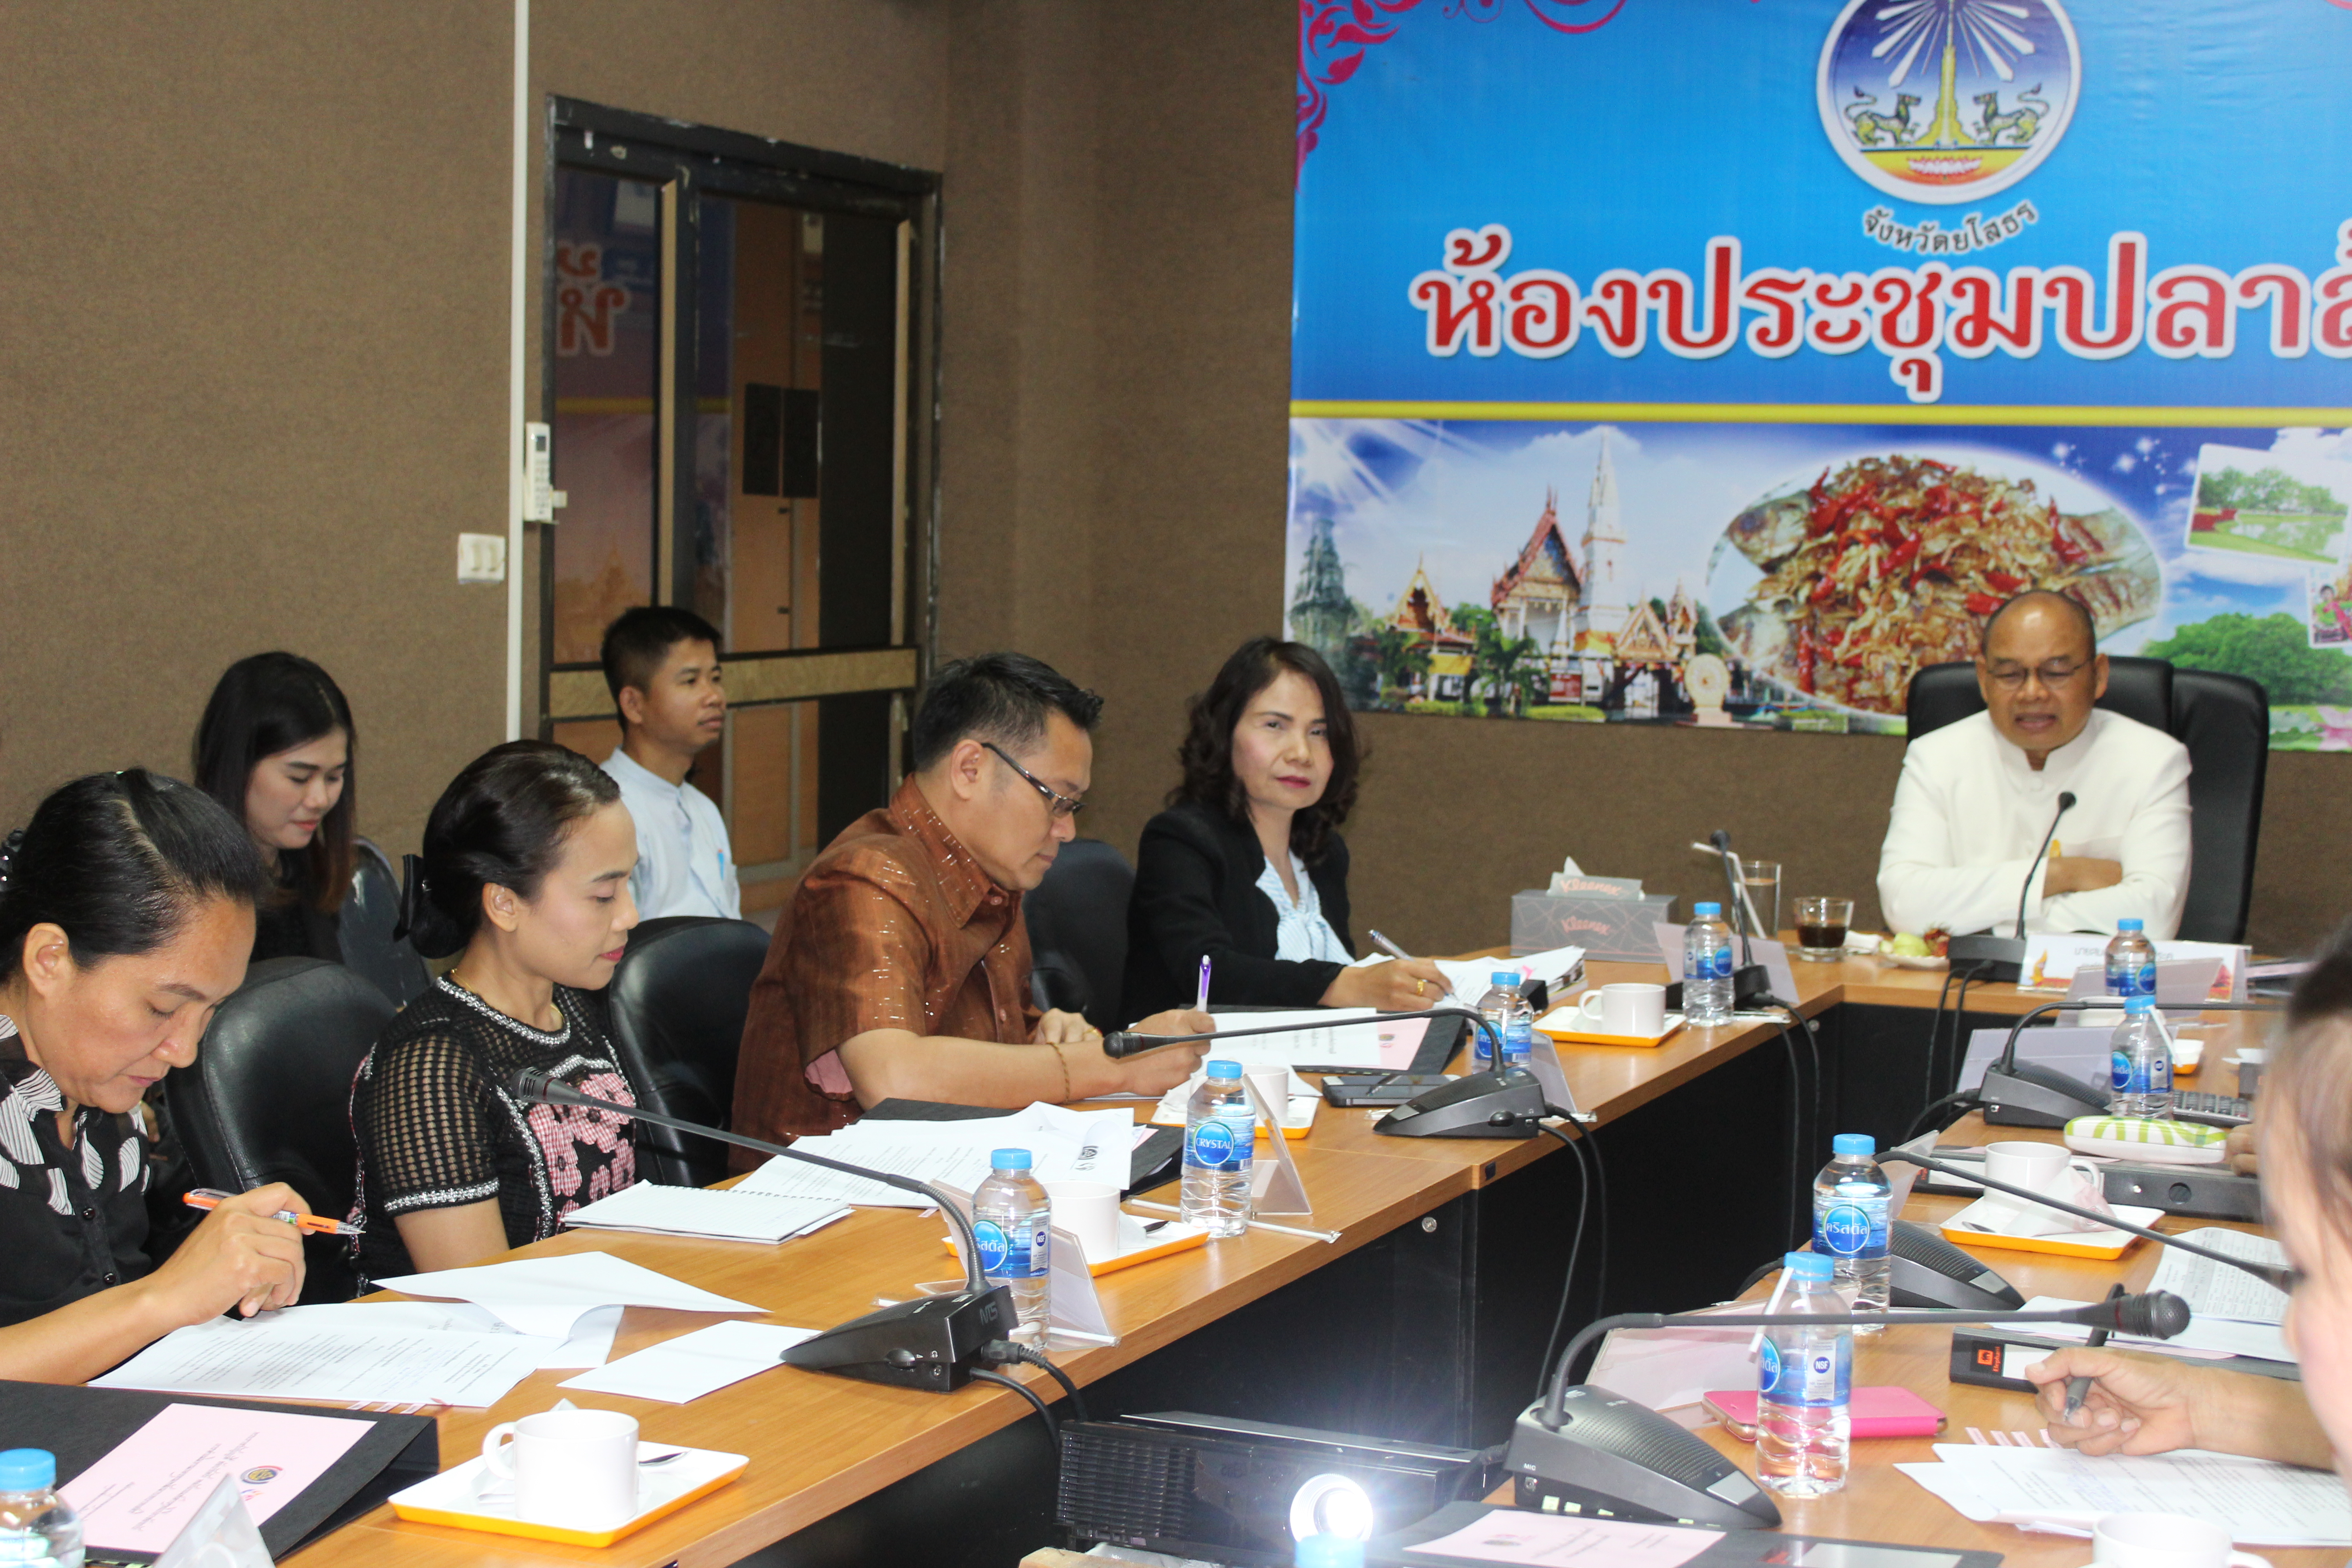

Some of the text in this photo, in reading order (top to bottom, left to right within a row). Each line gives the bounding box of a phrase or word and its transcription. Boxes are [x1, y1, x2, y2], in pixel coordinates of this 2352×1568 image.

[1865, 203, 2035, 252] จังหวัดยโสธร
[1561, 916, 1611, 936] Kleenex
[1196, 1137, 1231, 1149] CRYSTAL
[1826, 1221, 1867, 1235] คริสตัล
[1037, 1234, 1045, 1243] NSF
[1816, 1361, 1828, 1370] NSF
[1524, 1463, 1537, 1471] MIC
